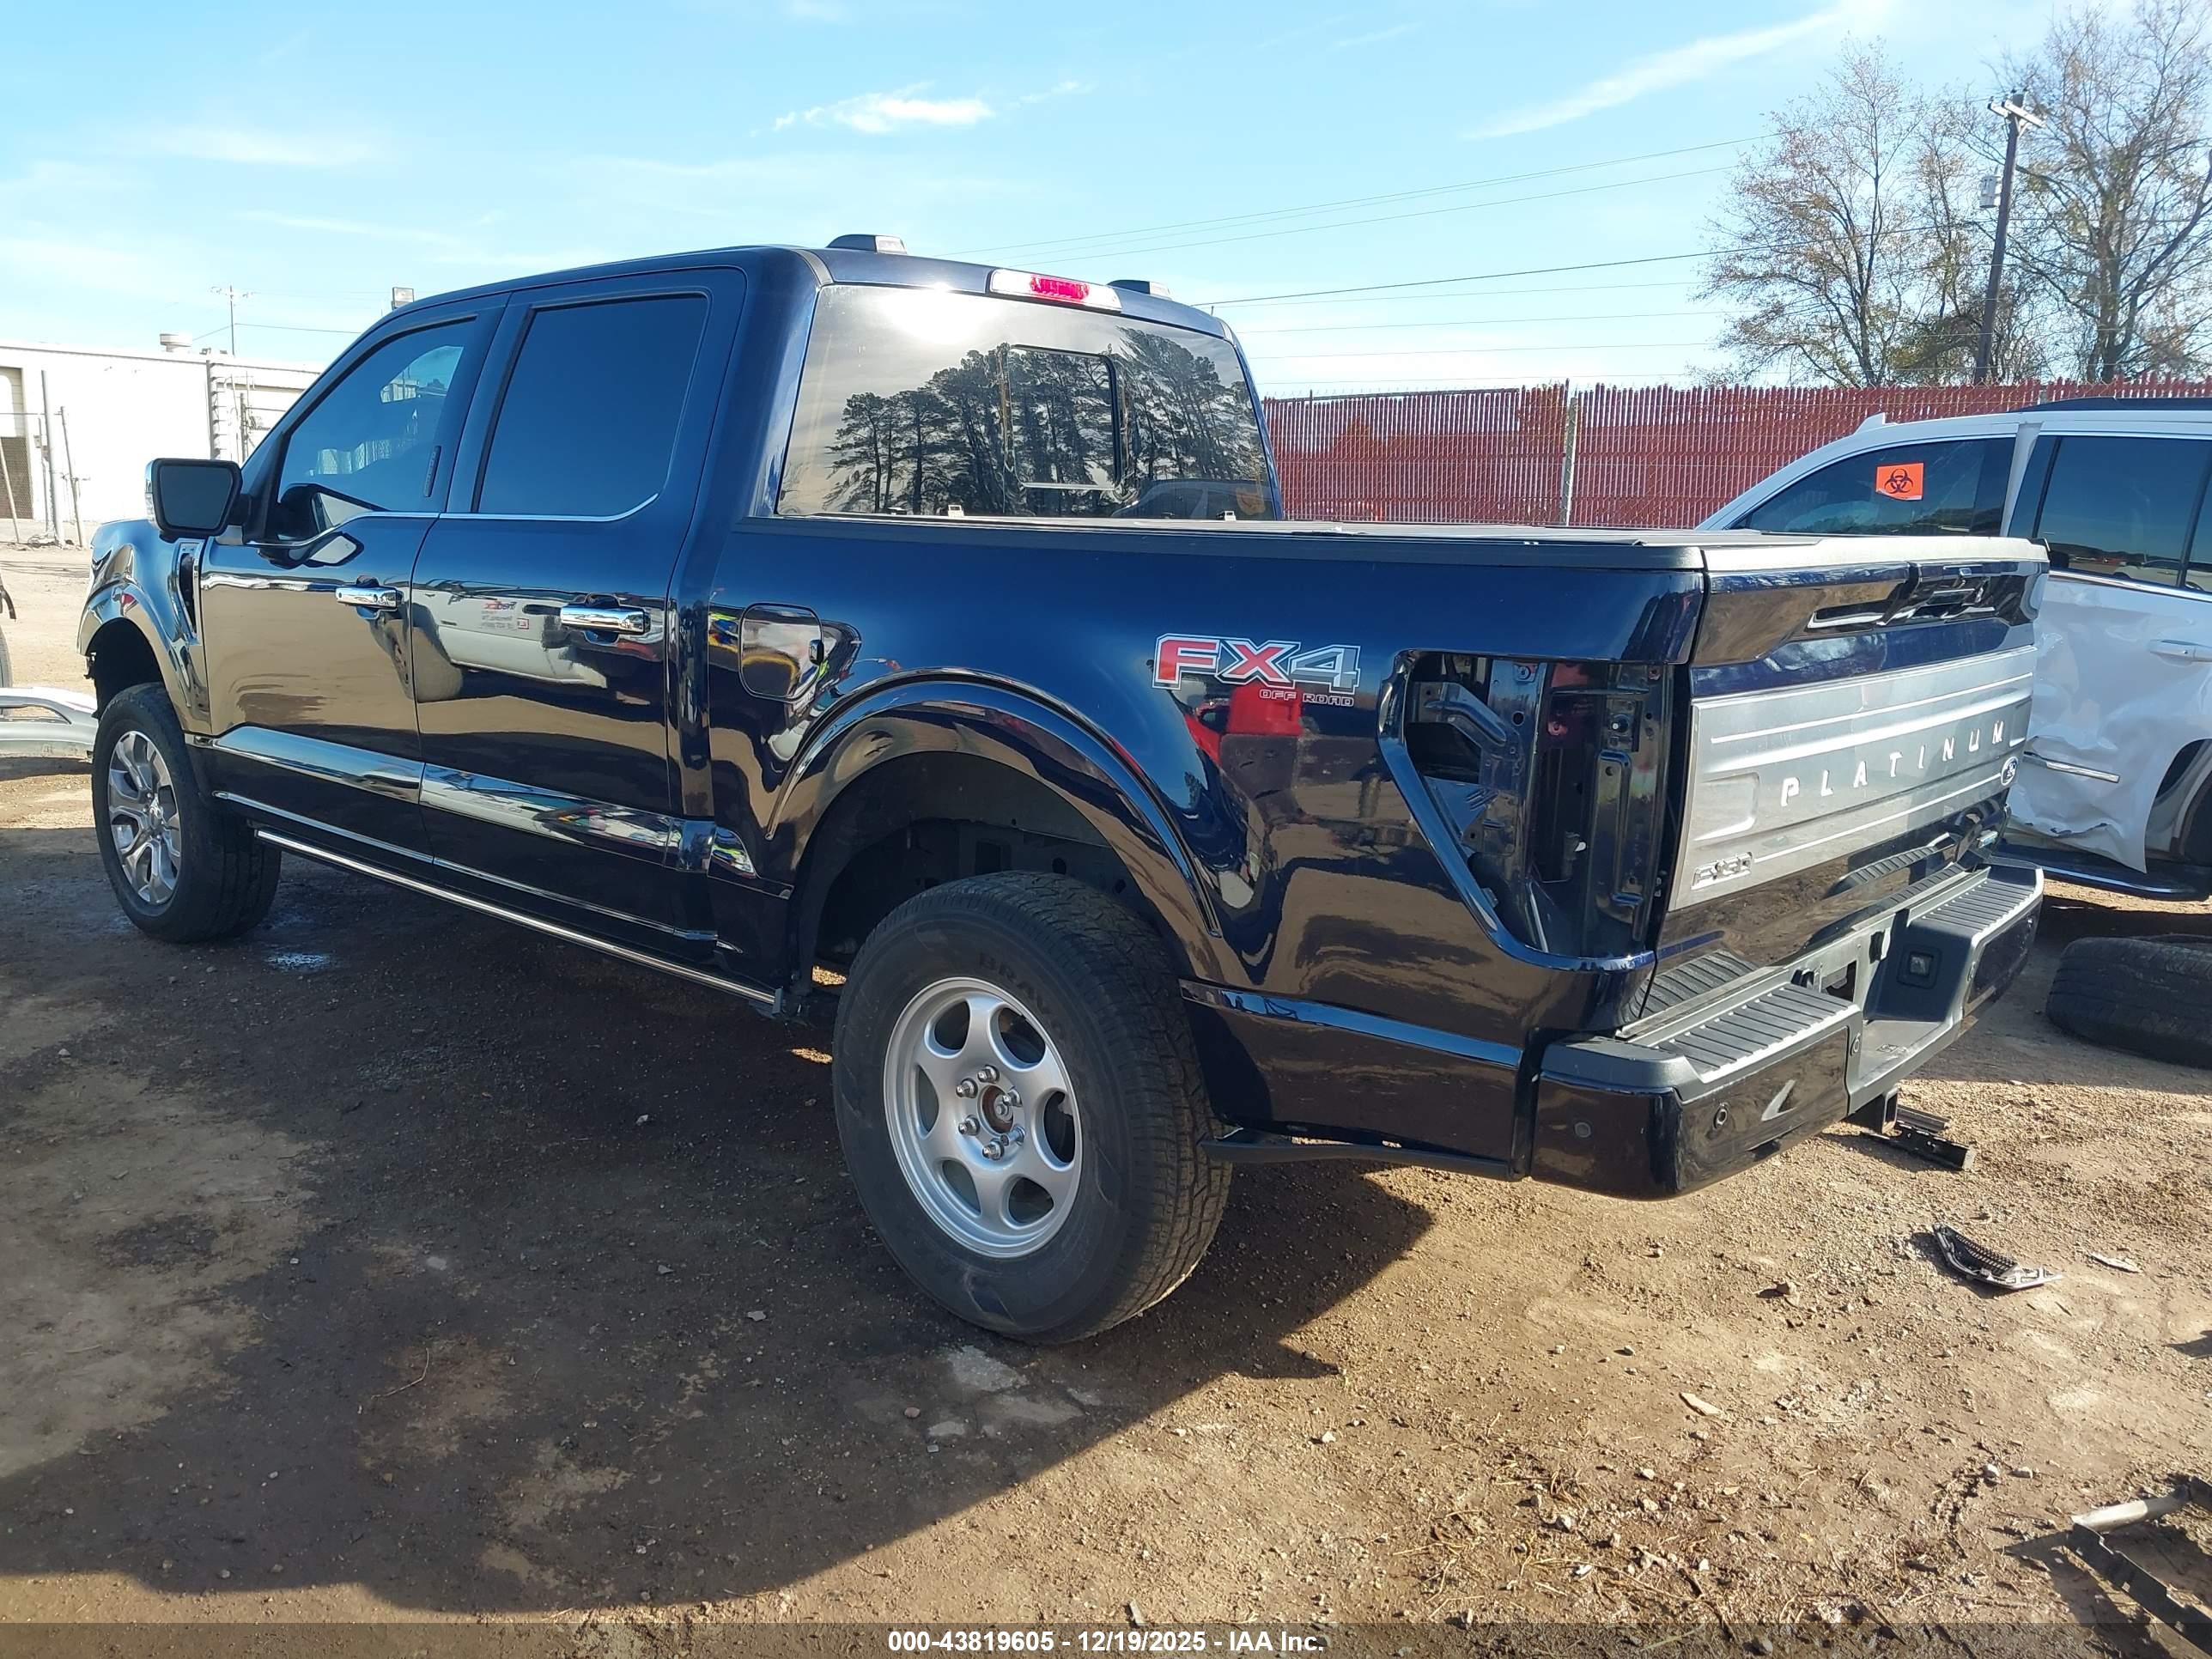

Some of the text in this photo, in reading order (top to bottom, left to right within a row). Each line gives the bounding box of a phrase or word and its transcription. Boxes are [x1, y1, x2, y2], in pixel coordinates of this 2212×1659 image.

[1152, 633, 1361, 694] FX4
[1259, 690, 1354, 707] OFF ROAD
[1780, 720, 2005, 807] PLATINUM
